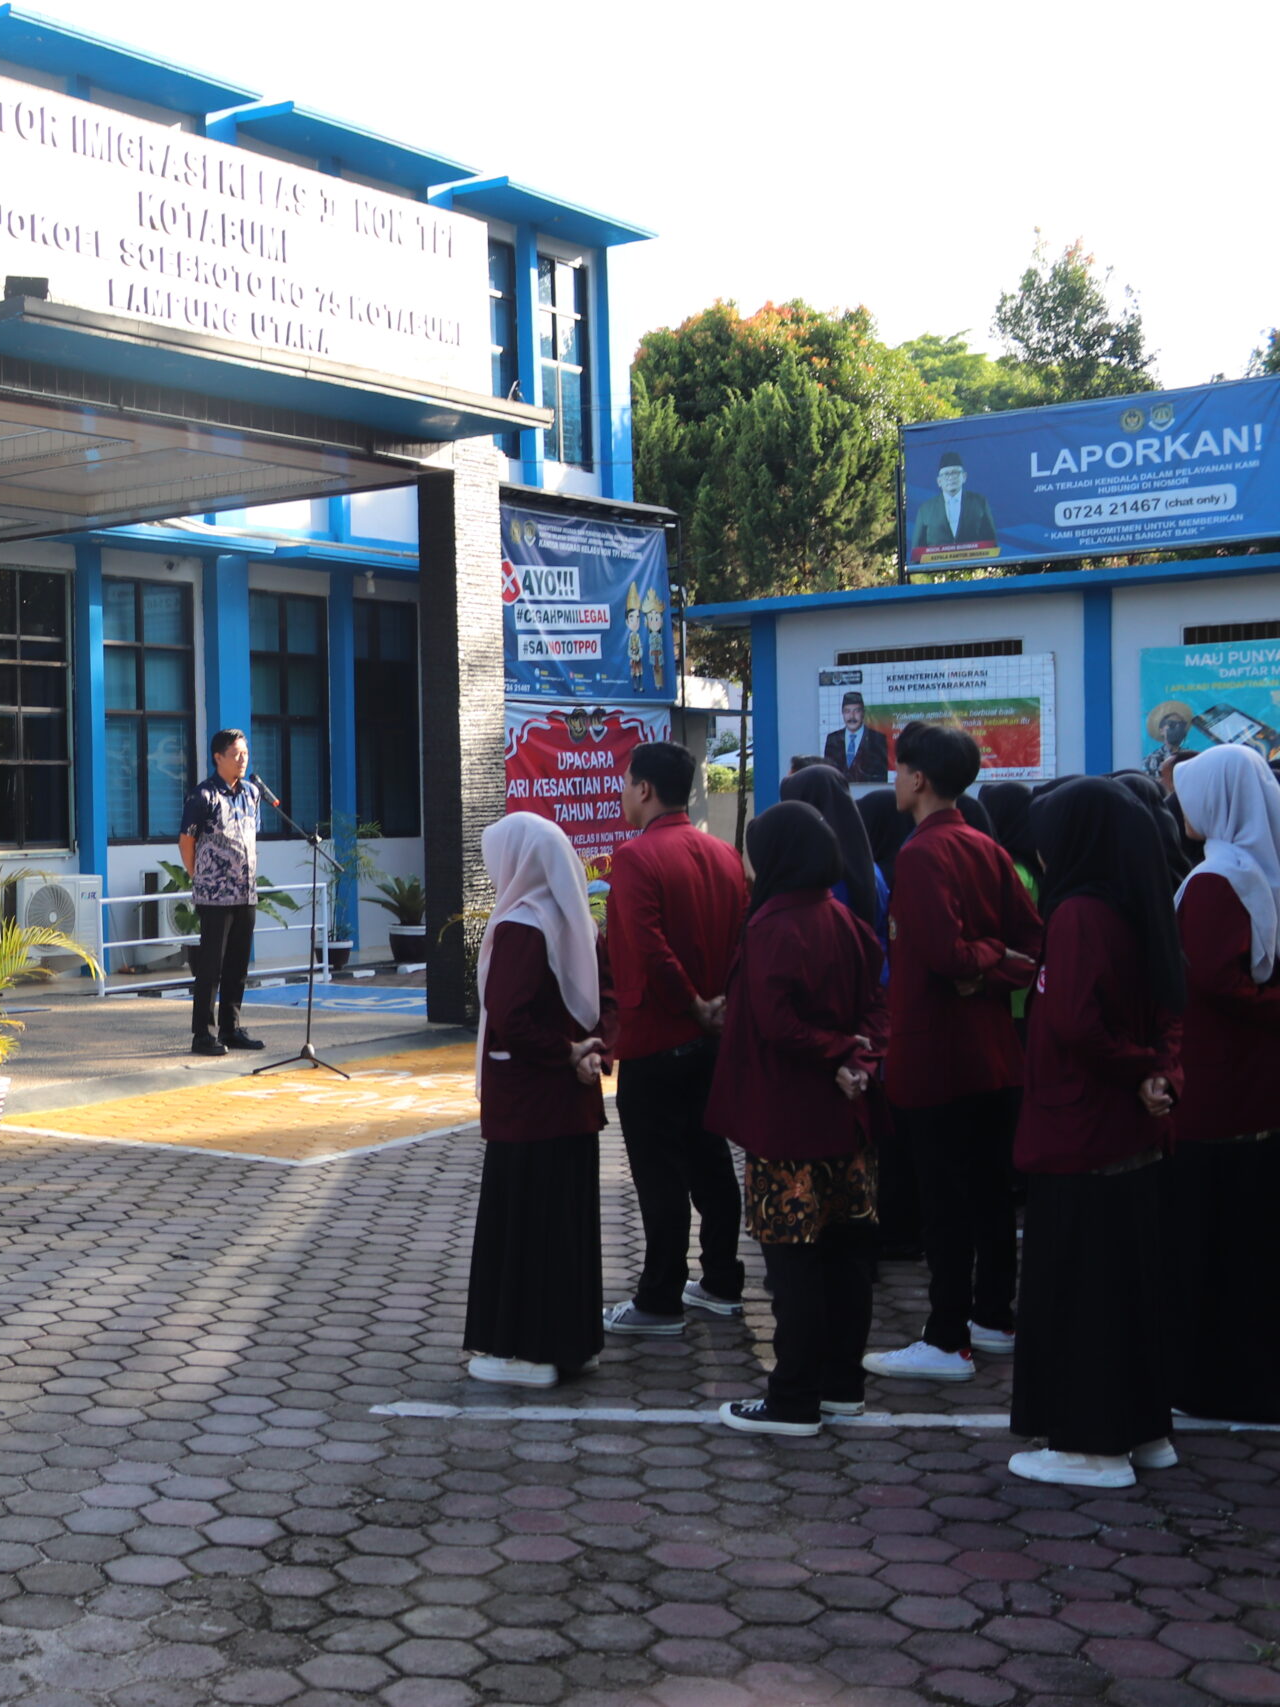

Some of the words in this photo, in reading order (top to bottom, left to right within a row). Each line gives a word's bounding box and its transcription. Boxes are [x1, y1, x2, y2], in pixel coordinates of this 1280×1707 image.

[72, 115, 210, 190] IMIGRASI
[219, 160, 308, 217] KELAS
[355, 199, 405, 246] NON
[138, 191, 289, 264] KOTABUMI
[108, 278, 237, 334] LAMPUNG
[1030, 424, 1263, 478] LAPORKAN!
[1033, 482, 1054, 493] JIKA
[1055, 479, 1093, 491] TERJADI
[1095, 475, 1138, 487] KENDALA
[1140, 470, 1173, 481] DALAM
[1175, 463, 1233, 478] PELAYANAN
[1235, 459, 1260, 470] KAMI
[1098, 482, 1140, 494] HUBUNGI
[1141, 480, 1152, 490] DI
[1153, 477, 1190, 489] NOMOR
[1062, 502, 1104, 521] 0724
[1109, 497, 1161, 517] 21467
[1165, 494, 1195, 510] (chat
[1050, 530, 1073, 541] KAMI
[1075, 524, 1142, 538] BERKOMITMEN
[1144, 520, 1176, 531] UNTUK
[1178, 513, 1244, 527] MEMBERIKAN
[1079, 533, 1132, 546] PELAYANAN
[1134, 530, 1172, 542] SANGAT
[1173, 527, 1198, 537] BAIK
[522, 568, 575, 596] AYO!!!
[1184, 652, 1223, 667] MAU
[886, 671, 945, 683] KEMENTERIAN
[947, 669, 988, 680] IMIGRASI
[1220, 666, 1268, 678] DAFTAR
[888, 682, 906, 692] DAN
[907, 680, 987, 692] PEMASYARAKATAN
[557, 750, 615, 771] UPACARA
[506, 778, 530, 799] ARI
[532, 776, 601, 798] KESAKTIAN
[603, 775, 626, 794] PAN
[553, 802, 594, 822] TAHUN
[596, 801, 621, 819] 2025
[573, 833, 595, 846] KELAS
[600, 832, 614, 843] NON
